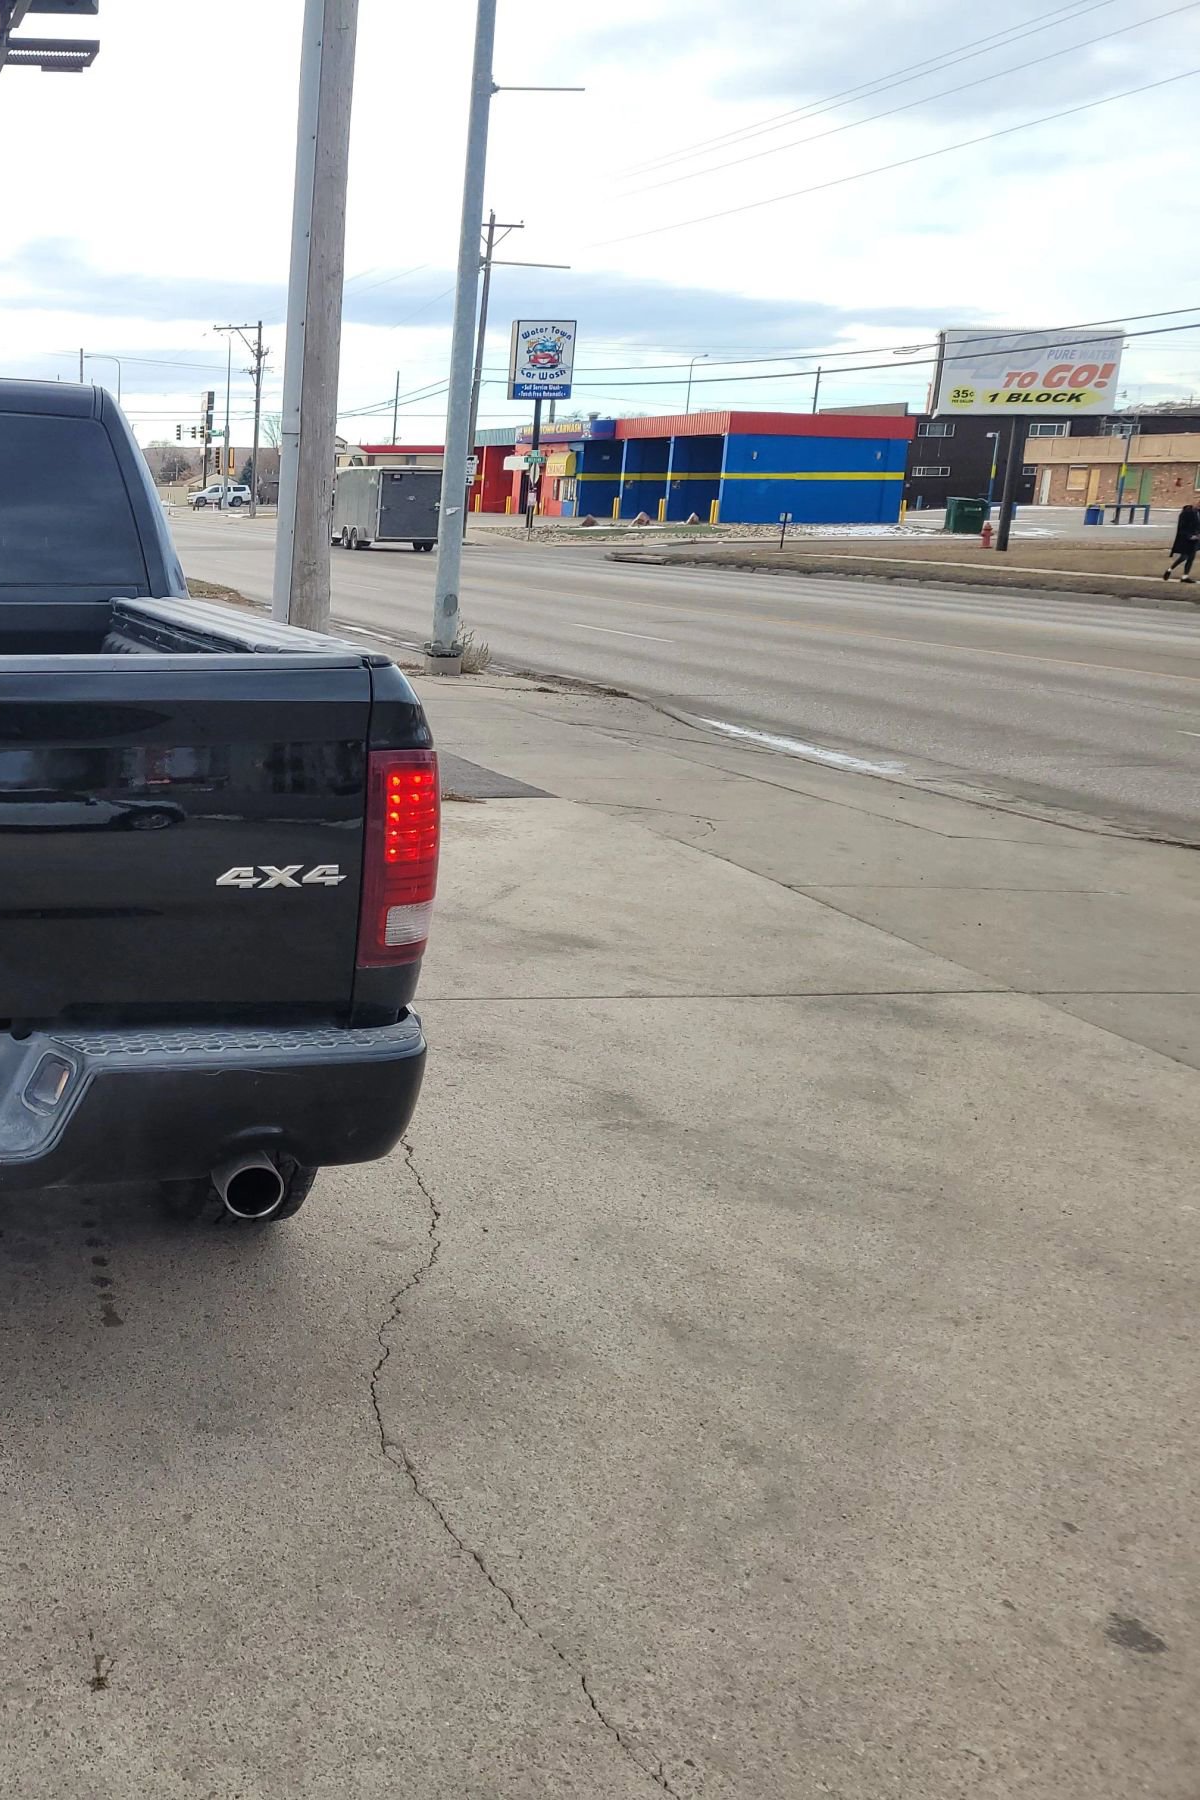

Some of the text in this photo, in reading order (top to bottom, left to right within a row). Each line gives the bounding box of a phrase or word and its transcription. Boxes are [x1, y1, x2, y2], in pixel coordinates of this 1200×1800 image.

[521, 326, 572, 341] Water Town
[1046, 349, 1117, 360] PURE WATER
[521, 368, 566, 380] Car Wash
[1002, 363, 1117, 389] TO GO!
[988, 392, 1086, 403] 1 BLOCK
[215, 864, 348, 889] 4X4
